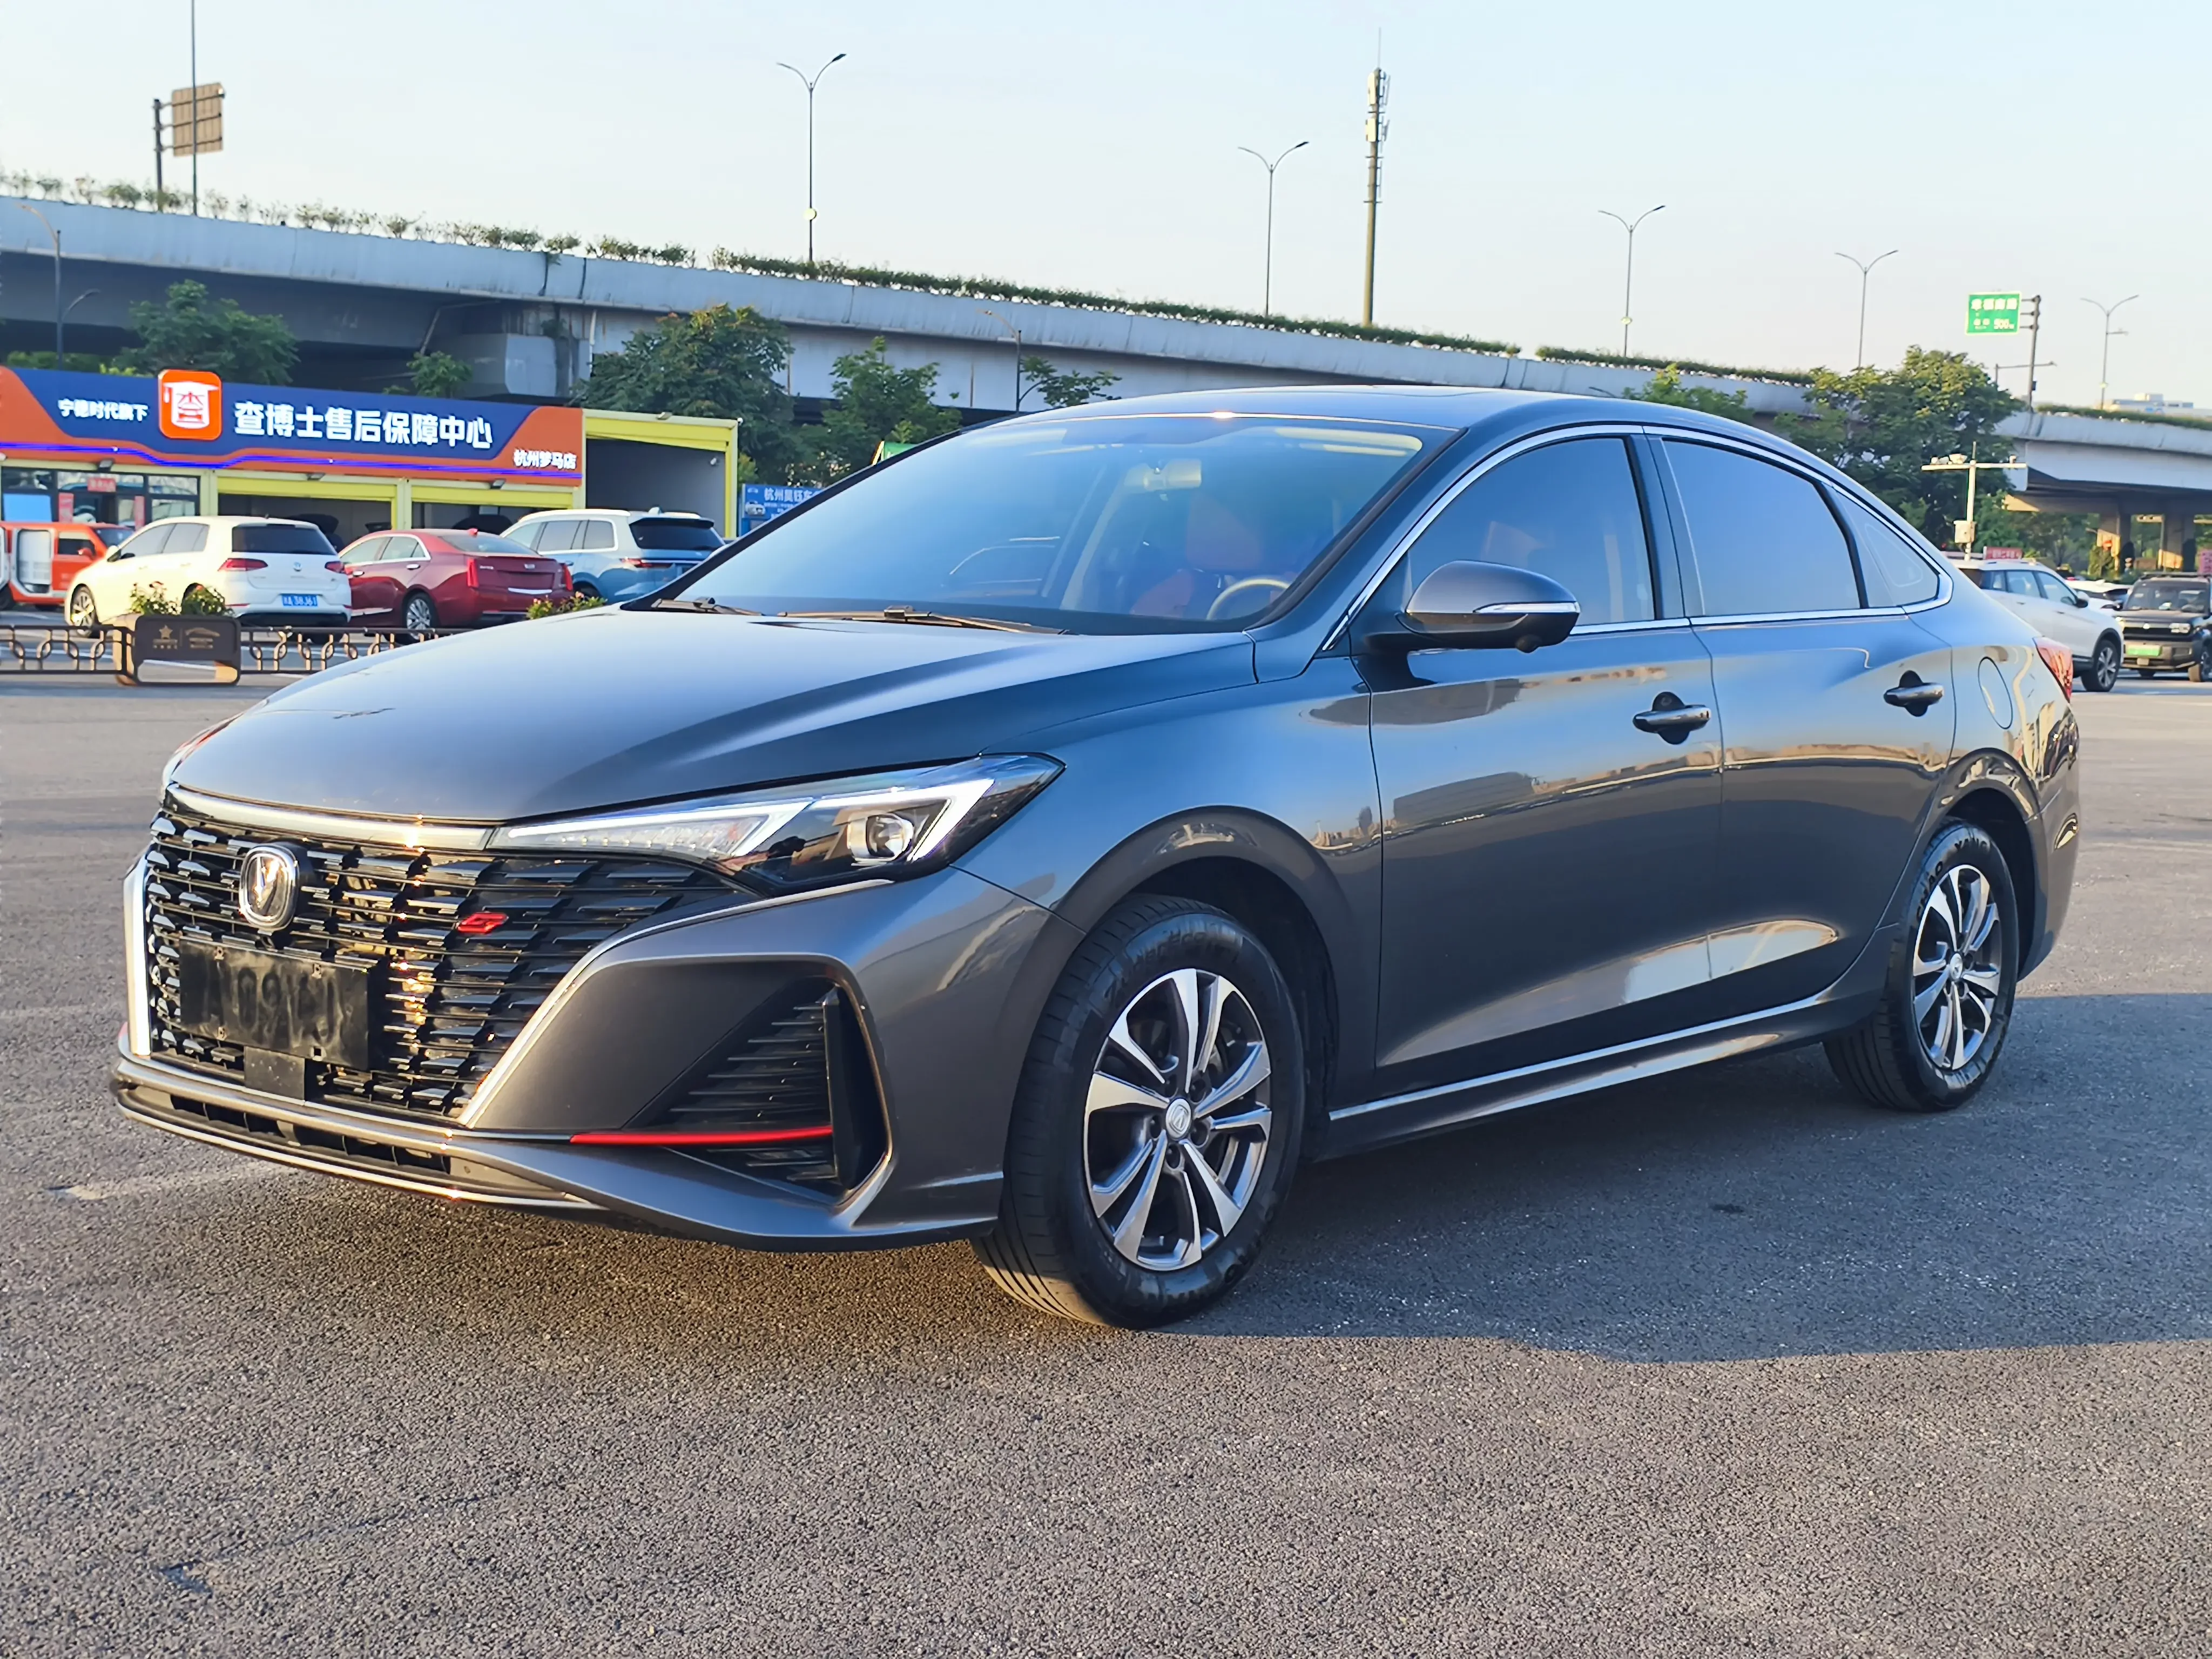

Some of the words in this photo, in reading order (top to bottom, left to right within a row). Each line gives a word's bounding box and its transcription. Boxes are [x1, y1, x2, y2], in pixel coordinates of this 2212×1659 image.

[57, 398, 149, 422] 宁德时代旗下
[234, 401, 494, 449] 查博士售后保障中心
